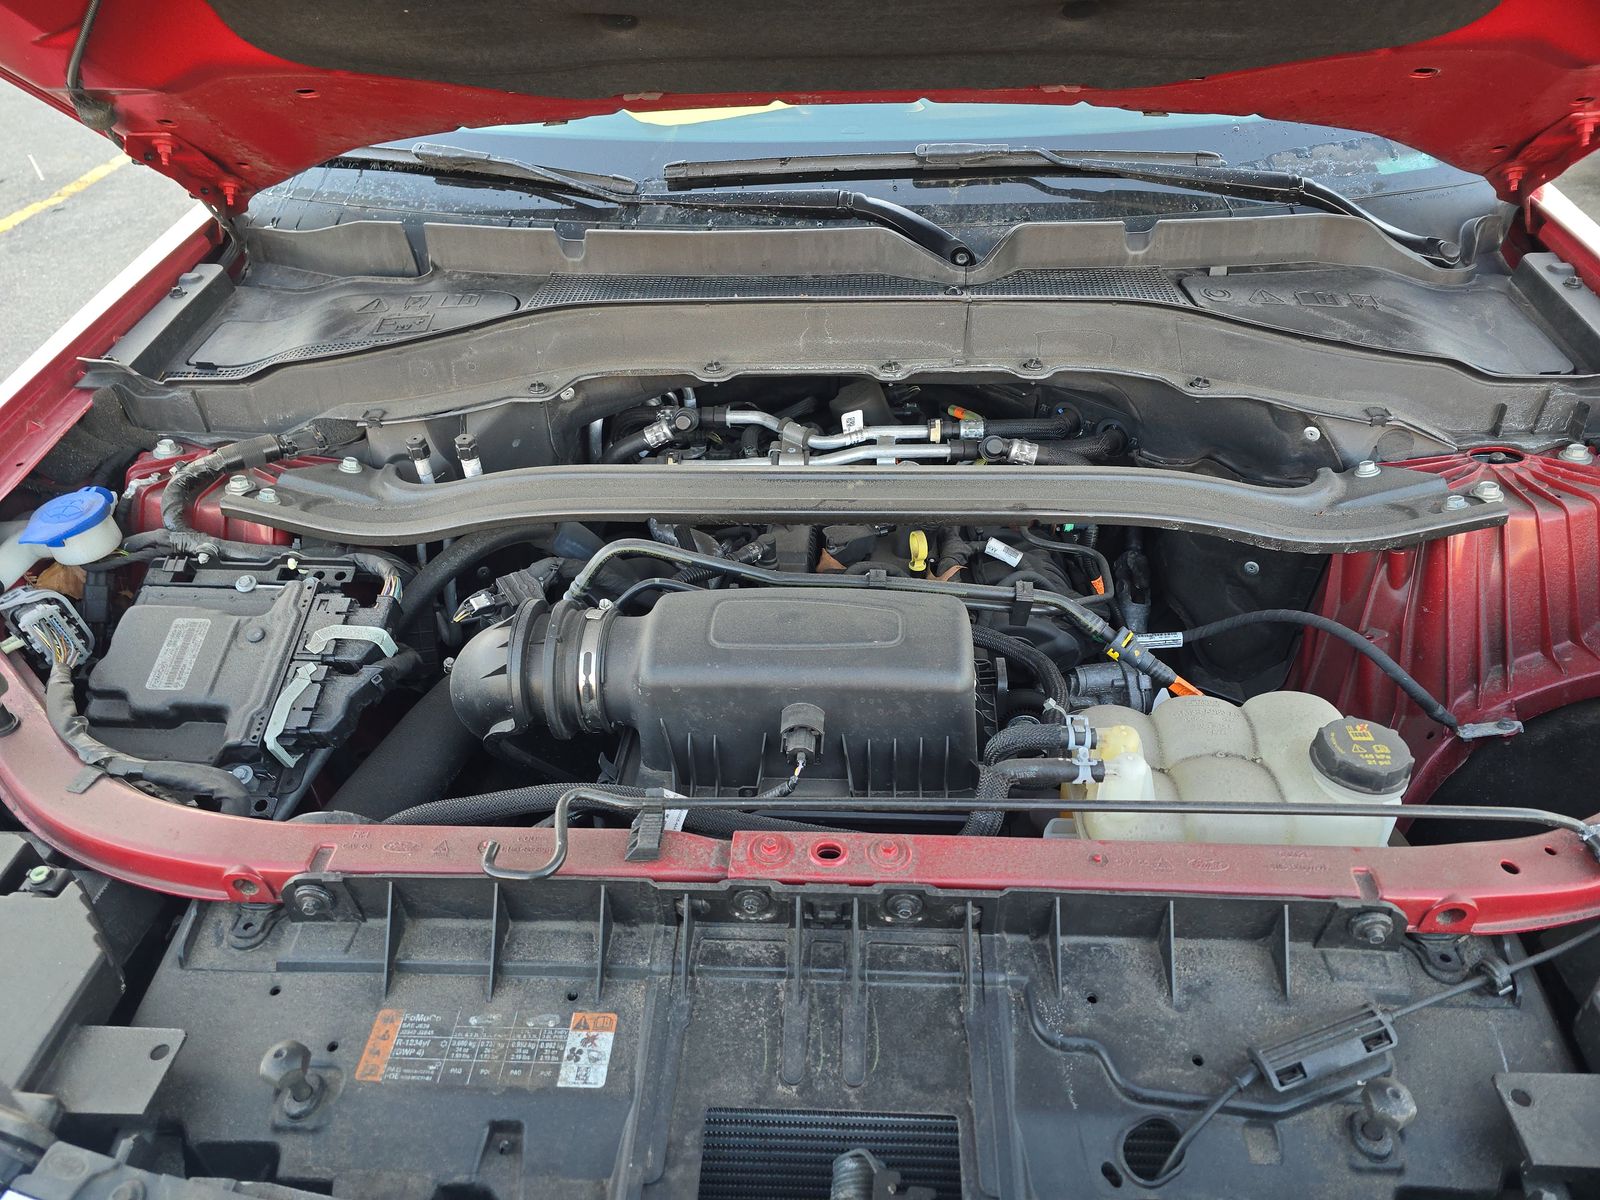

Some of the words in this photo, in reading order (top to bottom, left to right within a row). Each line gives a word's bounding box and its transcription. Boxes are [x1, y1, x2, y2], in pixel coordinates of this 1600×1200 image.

[404, 1013, 442, 1022] FoMoCo
[396, 1039, 431, 1048] R-1234yf
[392, 1048, 415, 1056] (GWP
